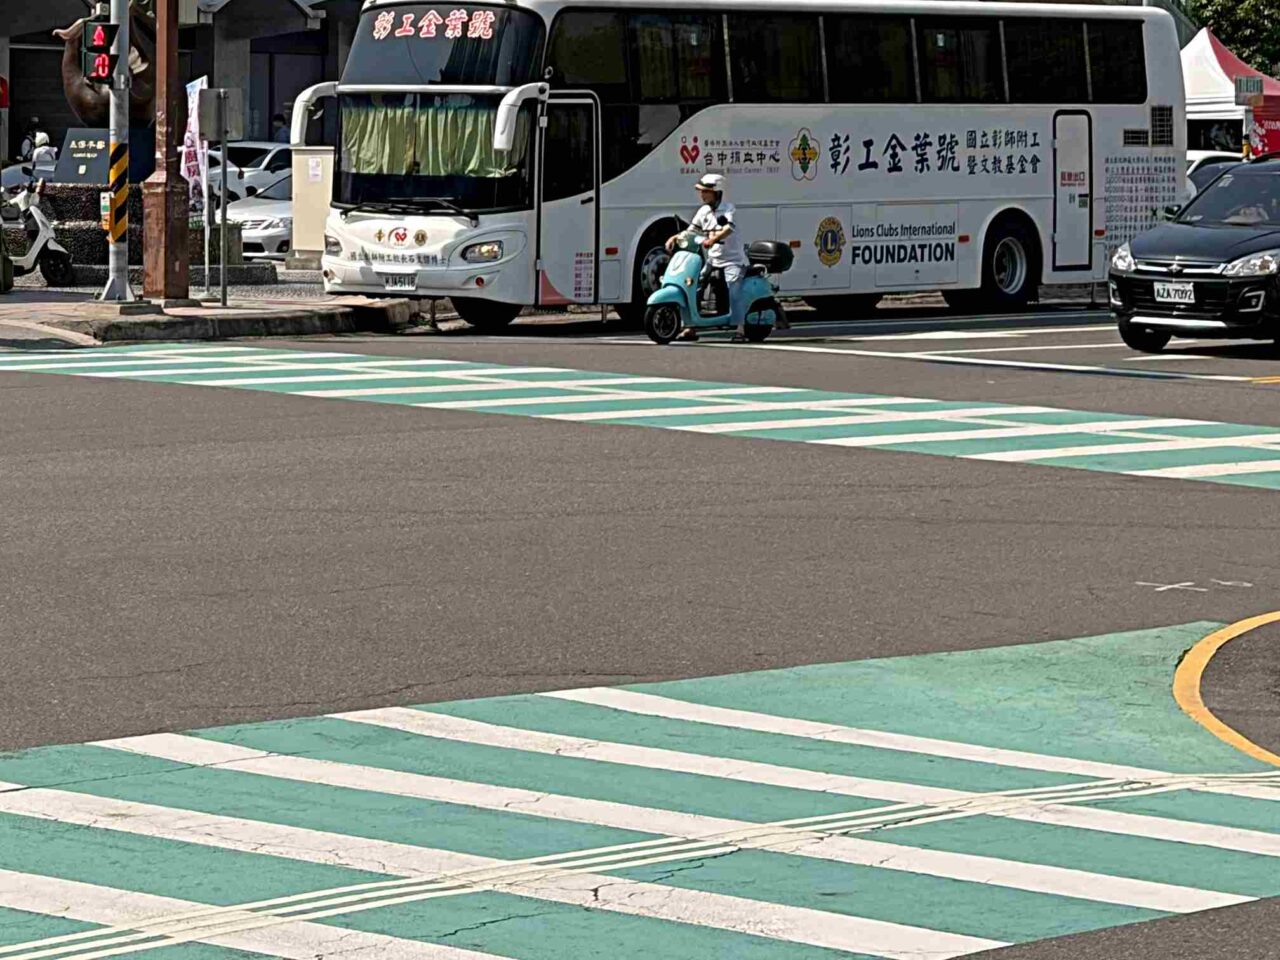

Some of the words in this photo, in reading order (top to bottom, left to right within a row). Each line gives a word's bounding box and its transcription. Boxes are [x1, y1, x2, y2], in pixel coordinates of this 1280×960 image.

[373, 9, 496, 40] 彰工金葉號
[966, 129, 1040, 149] 國立彰師附工
[704, 151, 780, 166] 台中捐血中心
[829, 133, 960, 175] 彰工金葉號
[967, 154, 1041, 175] 暨文教基金會
[852, 225, 875, 238] Lions
[876, 223, 899, 237] Clubs
[900, 221, 955, 236] International
[851, 242, 955, 265] FOUNDATION
